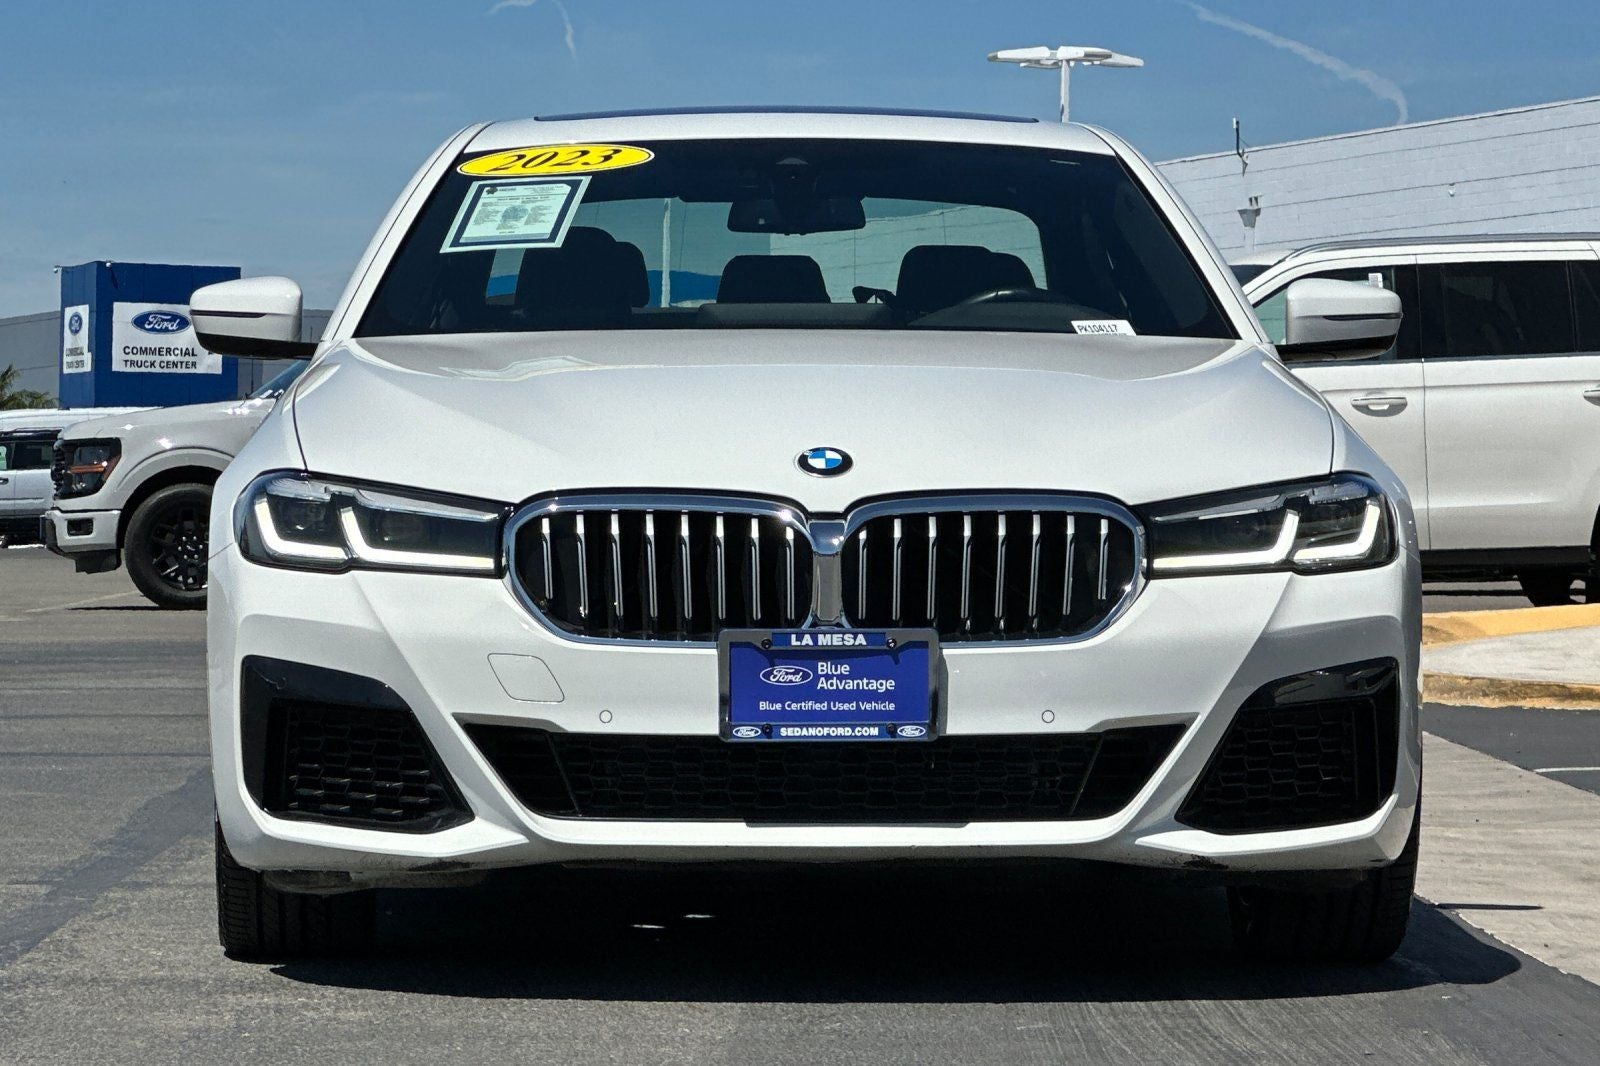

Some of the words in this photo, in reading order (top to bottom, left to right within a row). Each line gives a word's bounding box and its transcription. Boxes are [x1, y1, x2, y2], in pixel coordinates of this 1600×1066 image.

[486, 149, 623, 173] 2023
[144, 314, 179, 331] Ford
[1076, 324, 1118, 333] PK104117
[123, 346, 198, 357] COMMERCIAL
[123, 359, 157, 369] TRUCK
[159, 360, 197, 370] CENTER
[790, 634, 814, 646] LA
[817, 634, 867, 646] MESA
[817, 662, 850, 675] Blue
[769, 667, 803, 683] Ford
[816, 677, 896, 692] Advantage
[759, 701, 782, 711] Blue
[785, 701, 828, 711] Certified
[830, 701, 856, 711] Used
[859, 701, 896, 711] Vehicle
[780, 727, 879, 736] SEDANOFORD.COM
